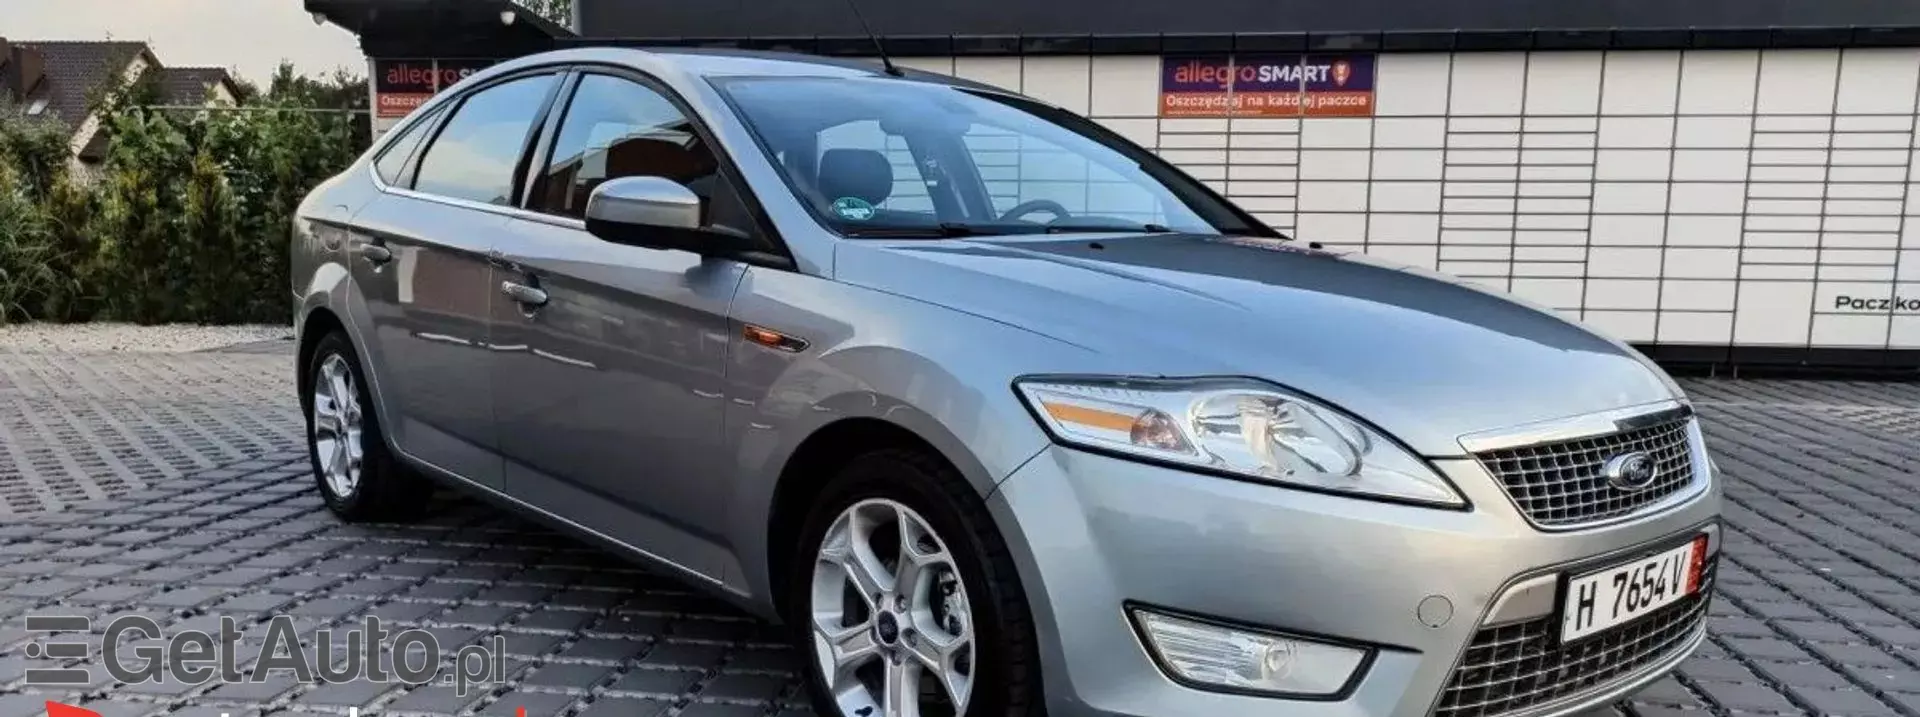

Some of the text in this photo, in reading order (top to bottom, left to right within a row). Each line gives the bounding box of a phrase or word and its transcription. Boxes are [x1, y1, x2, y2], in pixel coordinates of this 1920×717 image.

[1247, 96, 1263, 106] na
[1268, 93, 1315, 108] każdej
[1318, 95, 1367, 108] paczce
[1576, 581, 1598, 631] H
